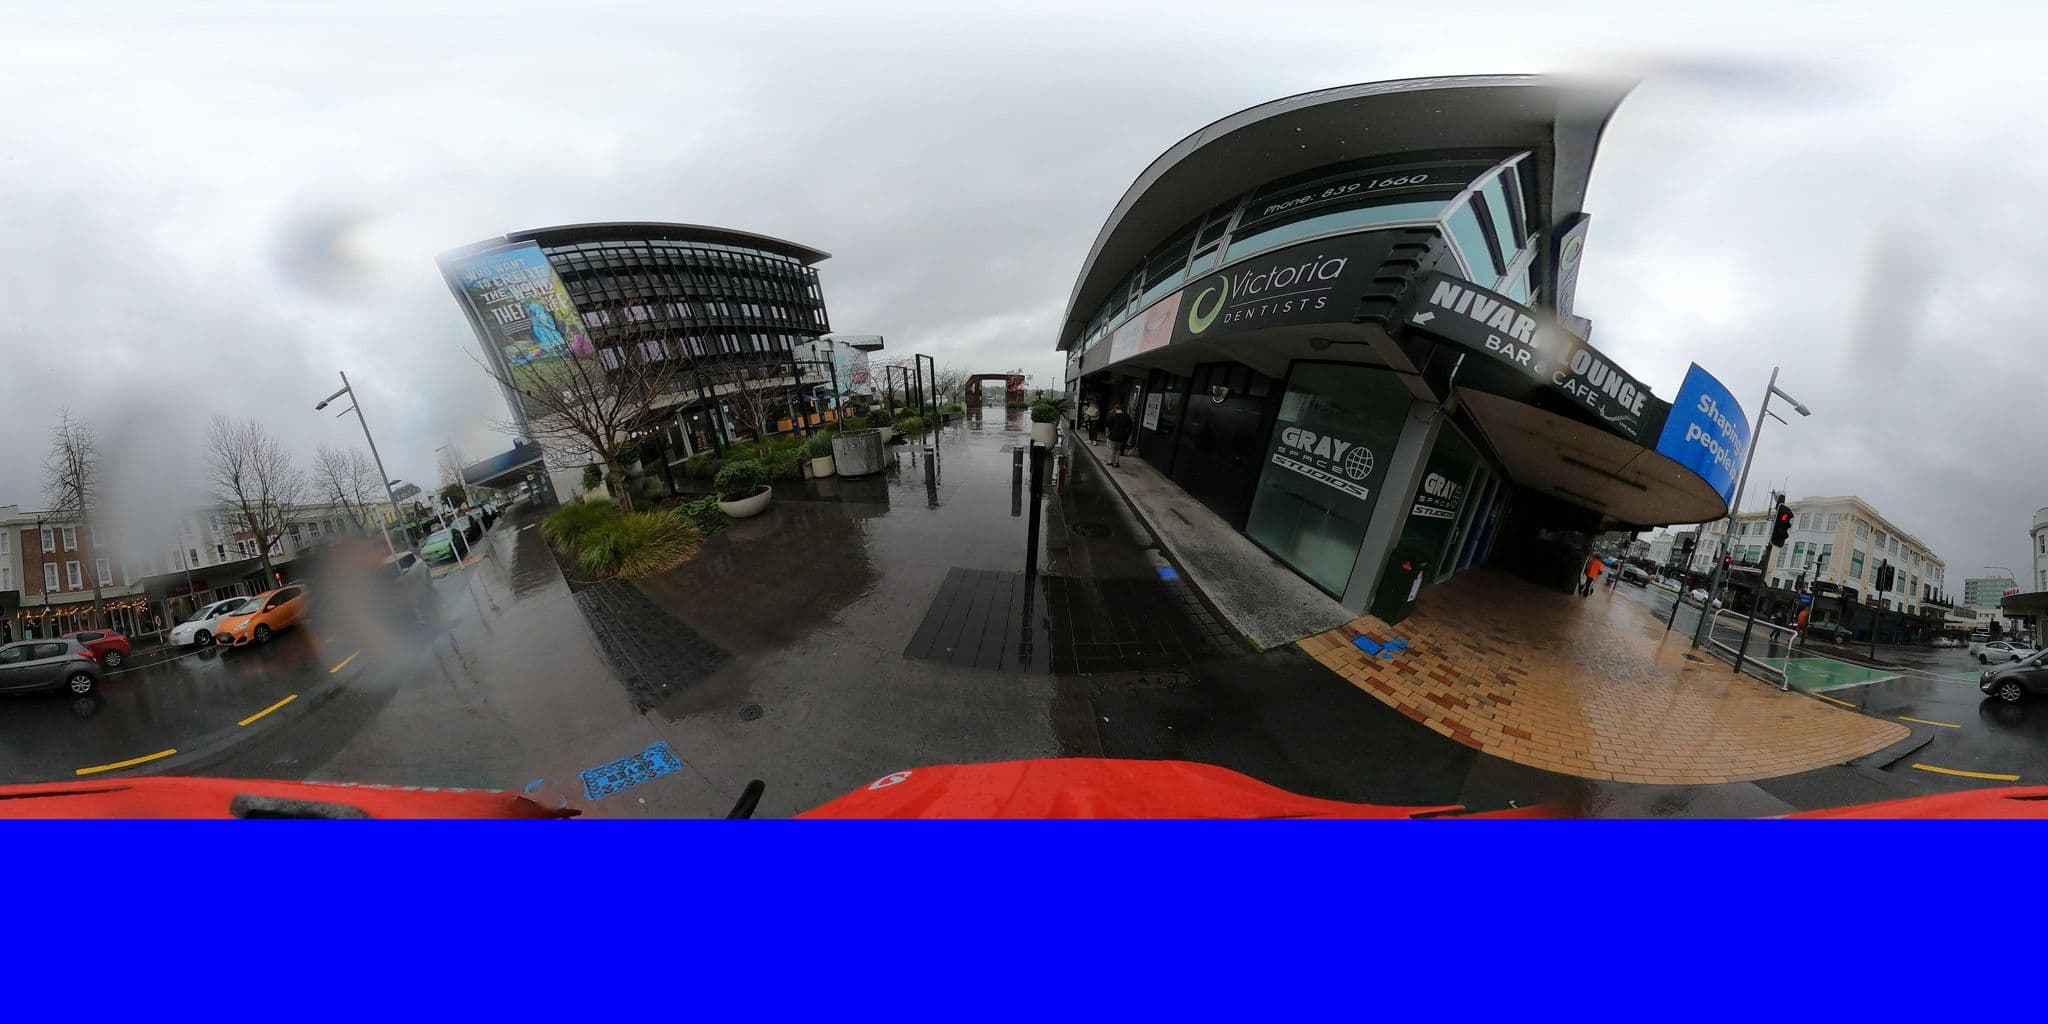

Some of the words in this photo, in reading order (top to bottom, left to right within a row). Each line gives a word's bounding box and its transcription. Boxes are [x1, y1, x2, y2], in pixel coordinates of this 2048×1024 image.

[1263, 193, 1318, 216] Phone:
[1321, 183, 1361, 198] 839
[1367, 174, 1429, 189] 1660
[480, 289, 507, 302] THE
[1232, 254, 1348, 299] Victoria
[491, 302, 527, 325] THEY
[1223, 296, 1328, 324] DENTISTS
[1429, 281, 1538, 349] NIVAR
[1560, 349, 1648, 417] OUNGE
[1485, 334, 1532, 366] BAR
[1552, 371, 1599, 408] CAFE
[1282, 426, 1351, 462] GRAY
[1697, 393, 1742, 457] Shaping
[1277, 446, 1344, 475] SPACE
[1685, 422, 1731, 472] people
[1273, 455, 1367, 498] STUDIOS
[1424, 472, 1457, 500] GRAY
